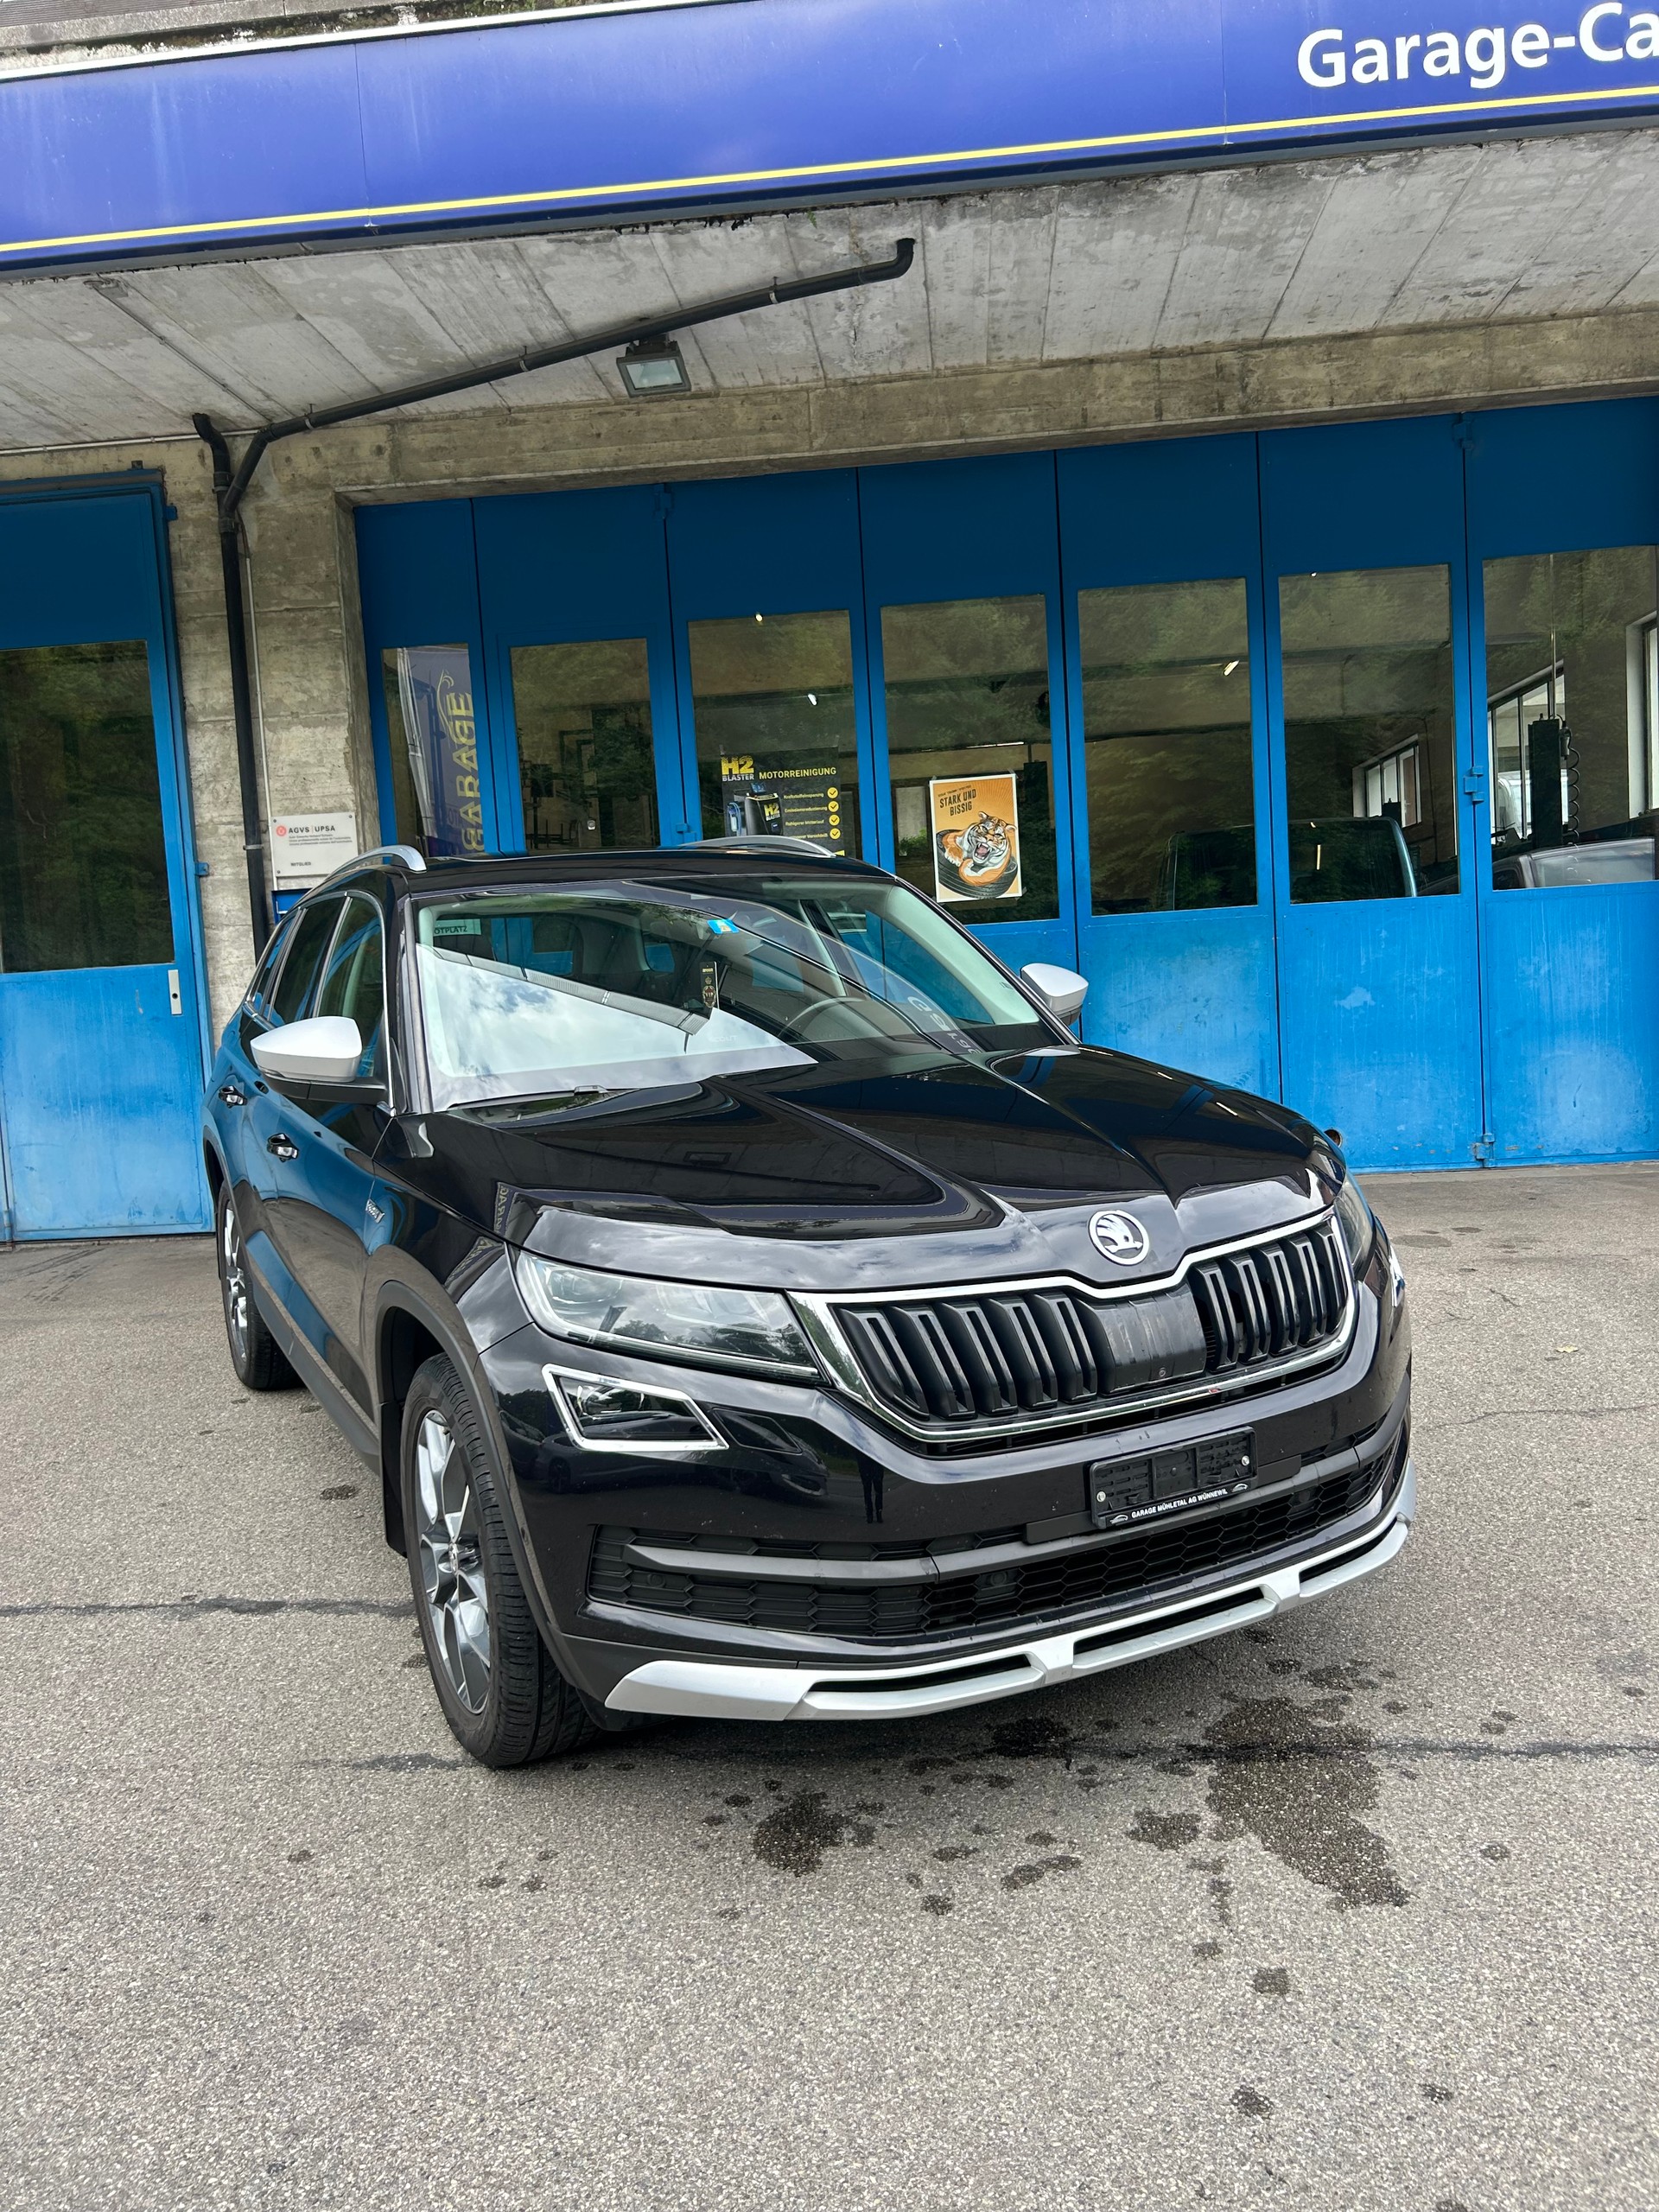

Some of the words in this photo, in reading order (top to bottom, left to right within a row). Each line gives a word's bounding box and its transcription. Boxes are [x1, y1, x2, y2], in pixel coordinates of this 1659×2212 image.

[1297, 1, 1659, 89] Garage-Ca
[721, 755, 754, 775] H2
[722, 773, 754, 782] BLASTER
[759, 766, 837, 780] MOTORREINIGUNG
[939, 792, 961, 809] STARK
[963, 788, 976, 802] UND
[764, 803, 780, 817] H2
[950, 801, 973, 817] BISSIG
[1131, 1506, 1157, 1519] GARAGE
[1157, 1498, 1188, 1512] MÜHLETAL
[1188, 1496, 1198, 1504] AG
[1197, 1488, 1228, 1502] WÜNNEWIL
